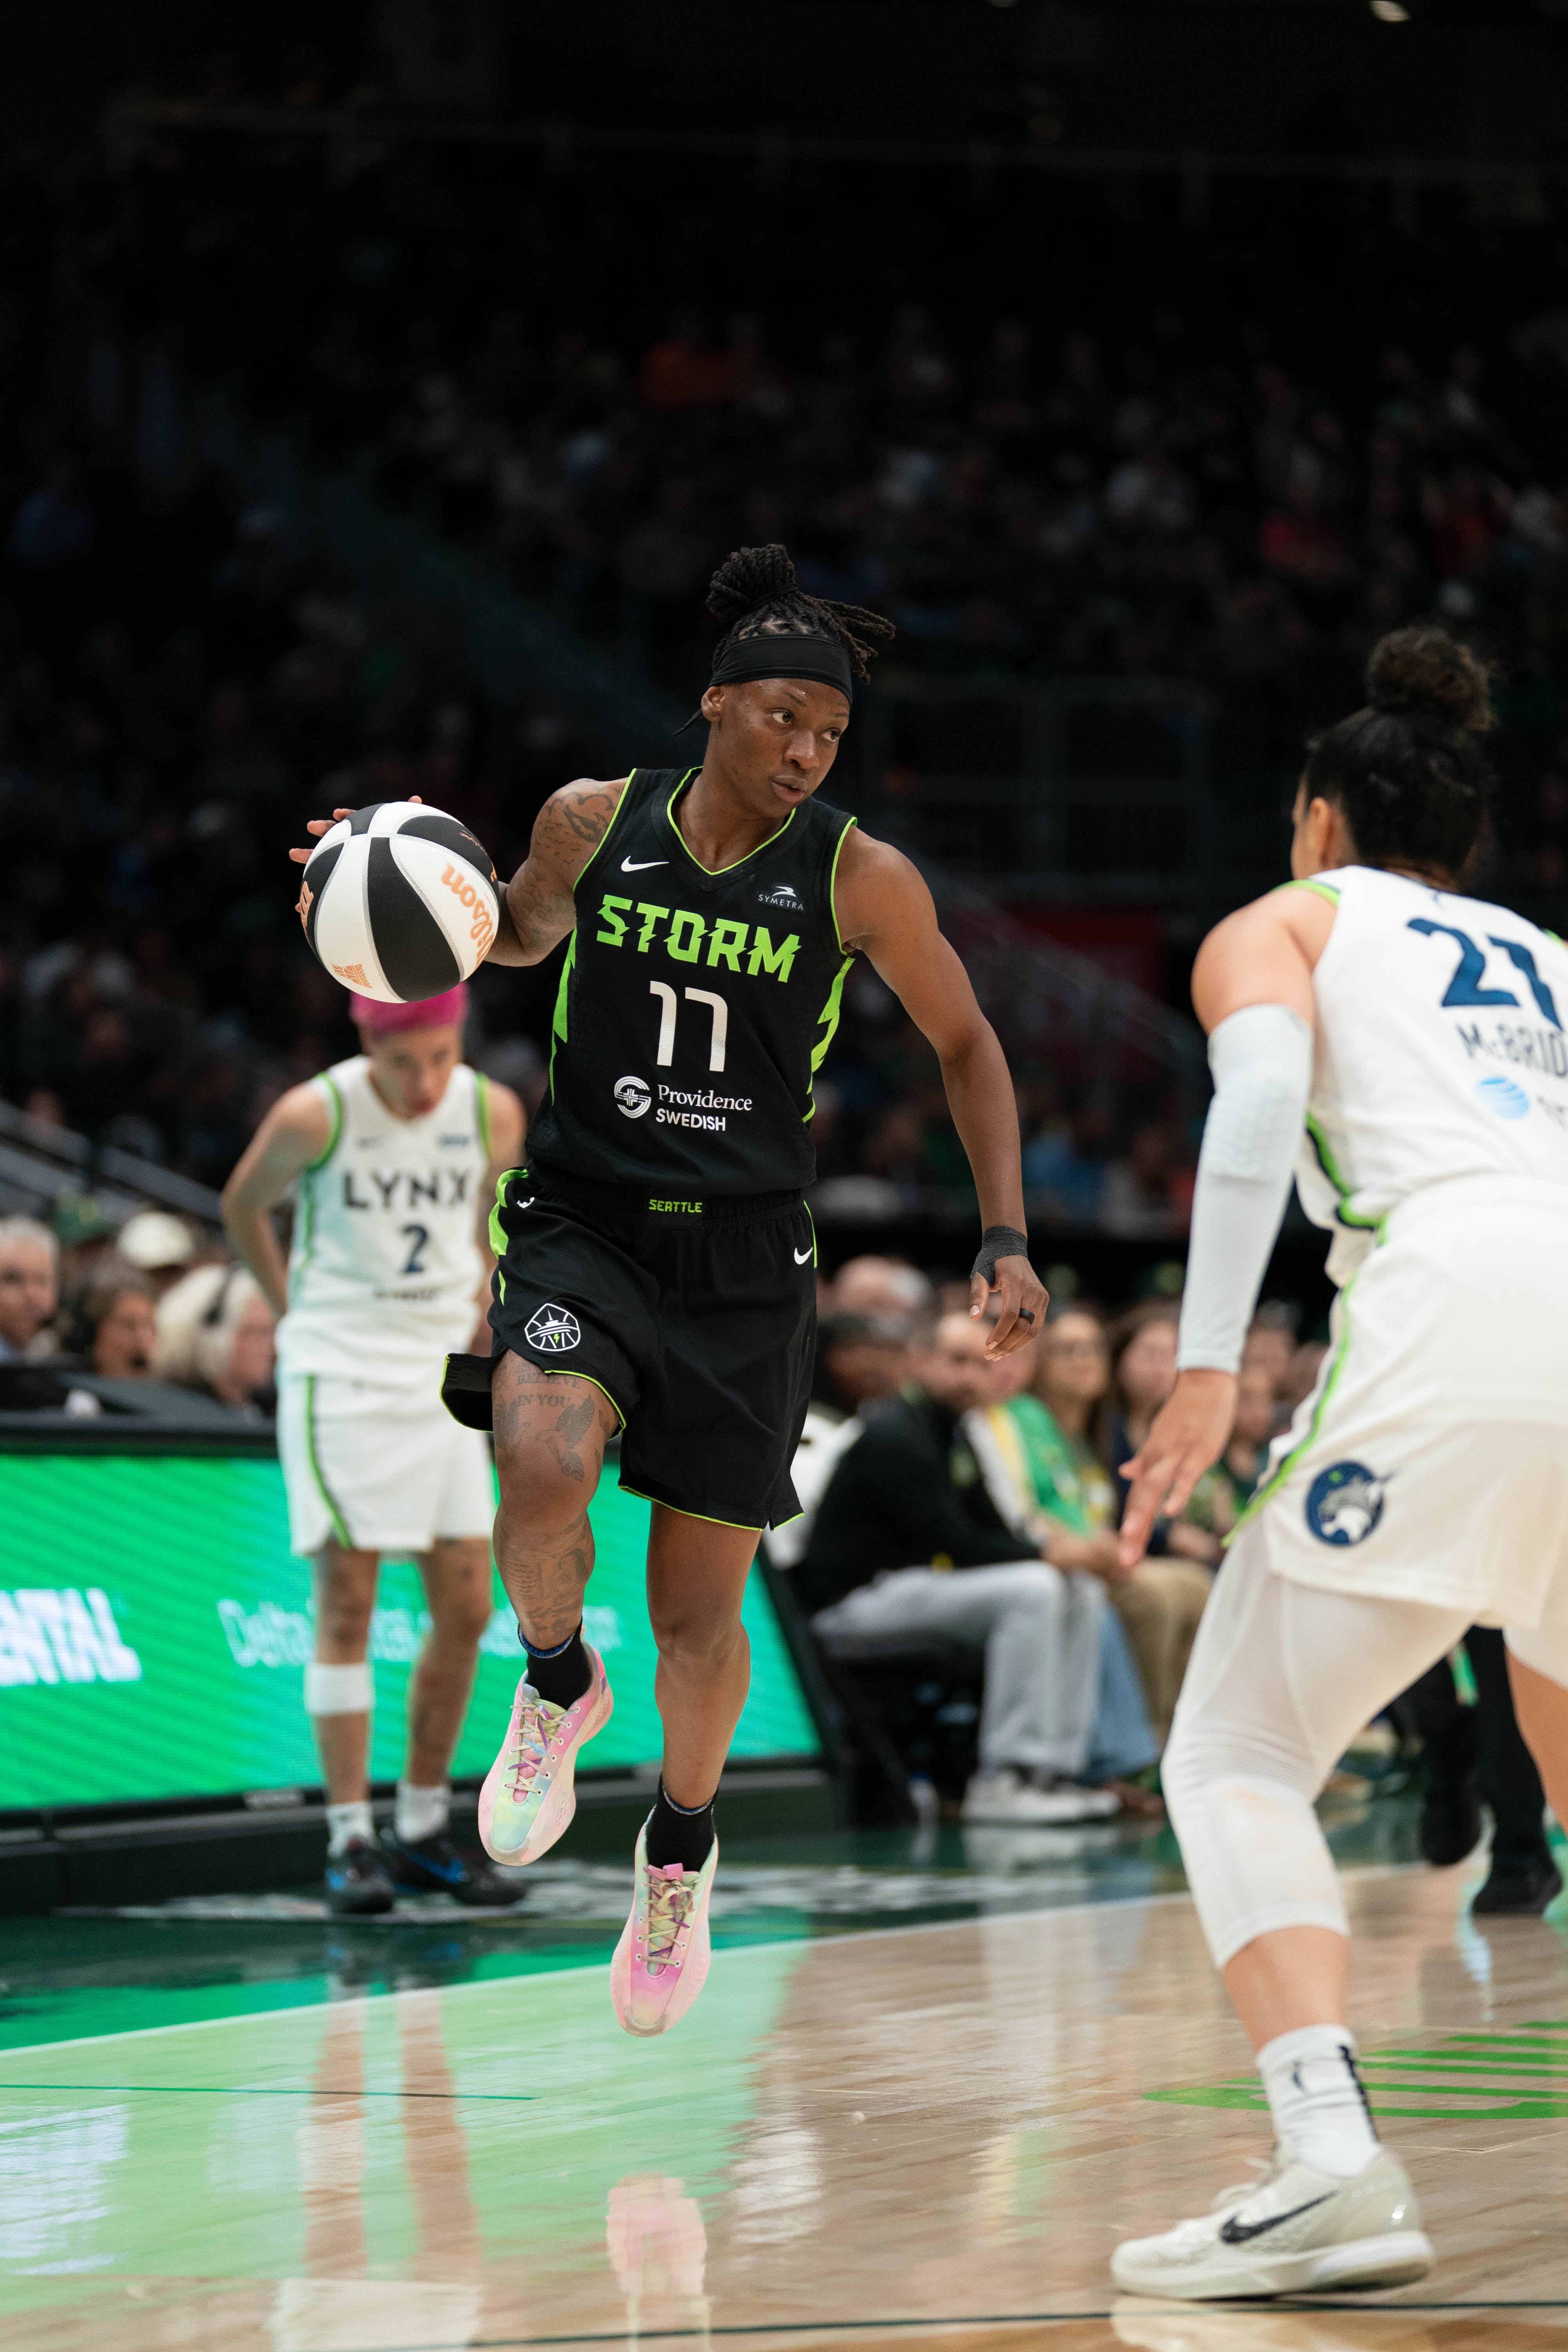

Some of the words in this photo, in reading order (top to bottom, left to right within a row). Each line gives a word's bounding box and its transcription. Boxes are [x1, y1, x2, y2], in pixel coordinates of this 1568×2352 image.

[758, 894, 804, 911] SYMETRA
[597, 894, 802, 983] STORM
[1406, 918, 1564, 1032] 21
[650, 980, 728, 1072] 17
[657, 1084, 753, 1111] Providence
[655, 1108, 726, 1131] SWEDISH
[342, 1167, 472, 1210] LYNX
[649, 1199, 702, 1213] SEATTLE
[400, 1221, 430, 1275] 2
[537, 1394, 571, 1408] YOU
